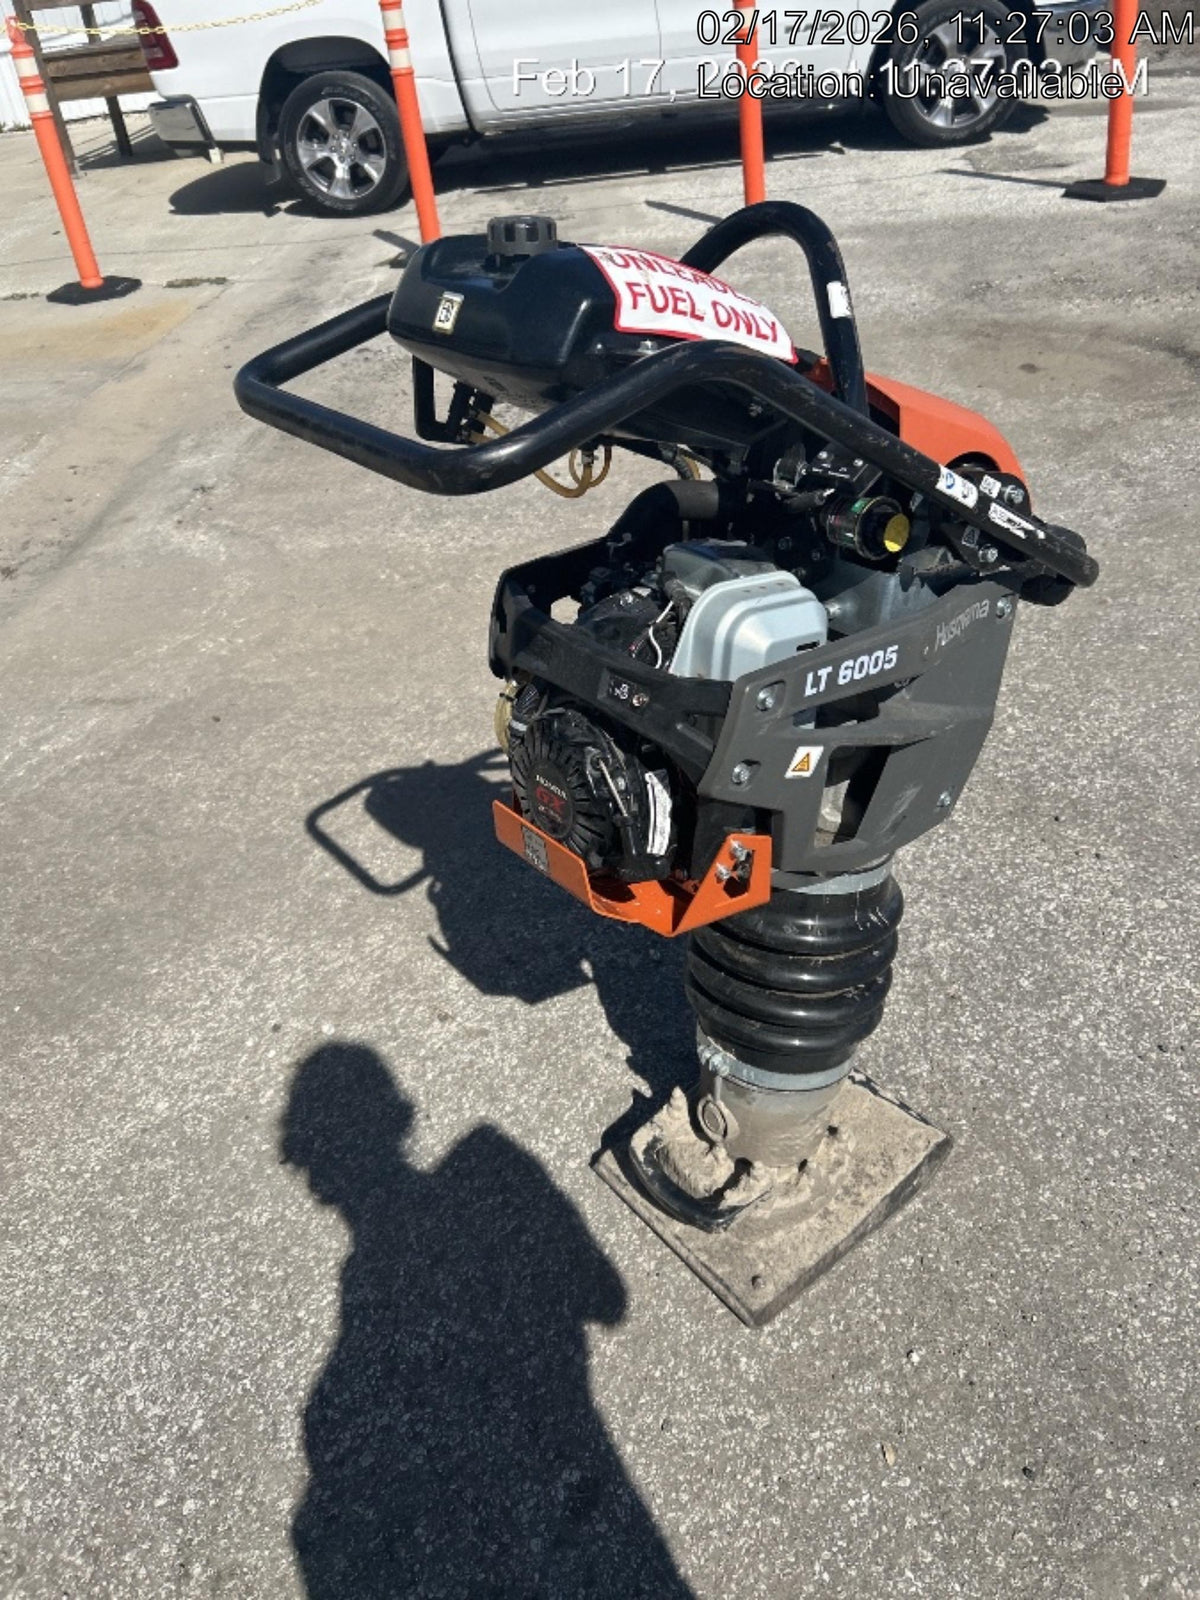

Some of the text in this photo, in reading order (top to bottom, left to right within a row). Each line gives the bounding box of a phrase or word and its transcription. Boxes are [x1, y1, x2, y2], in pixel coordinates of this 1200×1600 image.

[625, 281, 778, 344] FUEL ONLY
[804, 644, 899, 697] LT 6005
